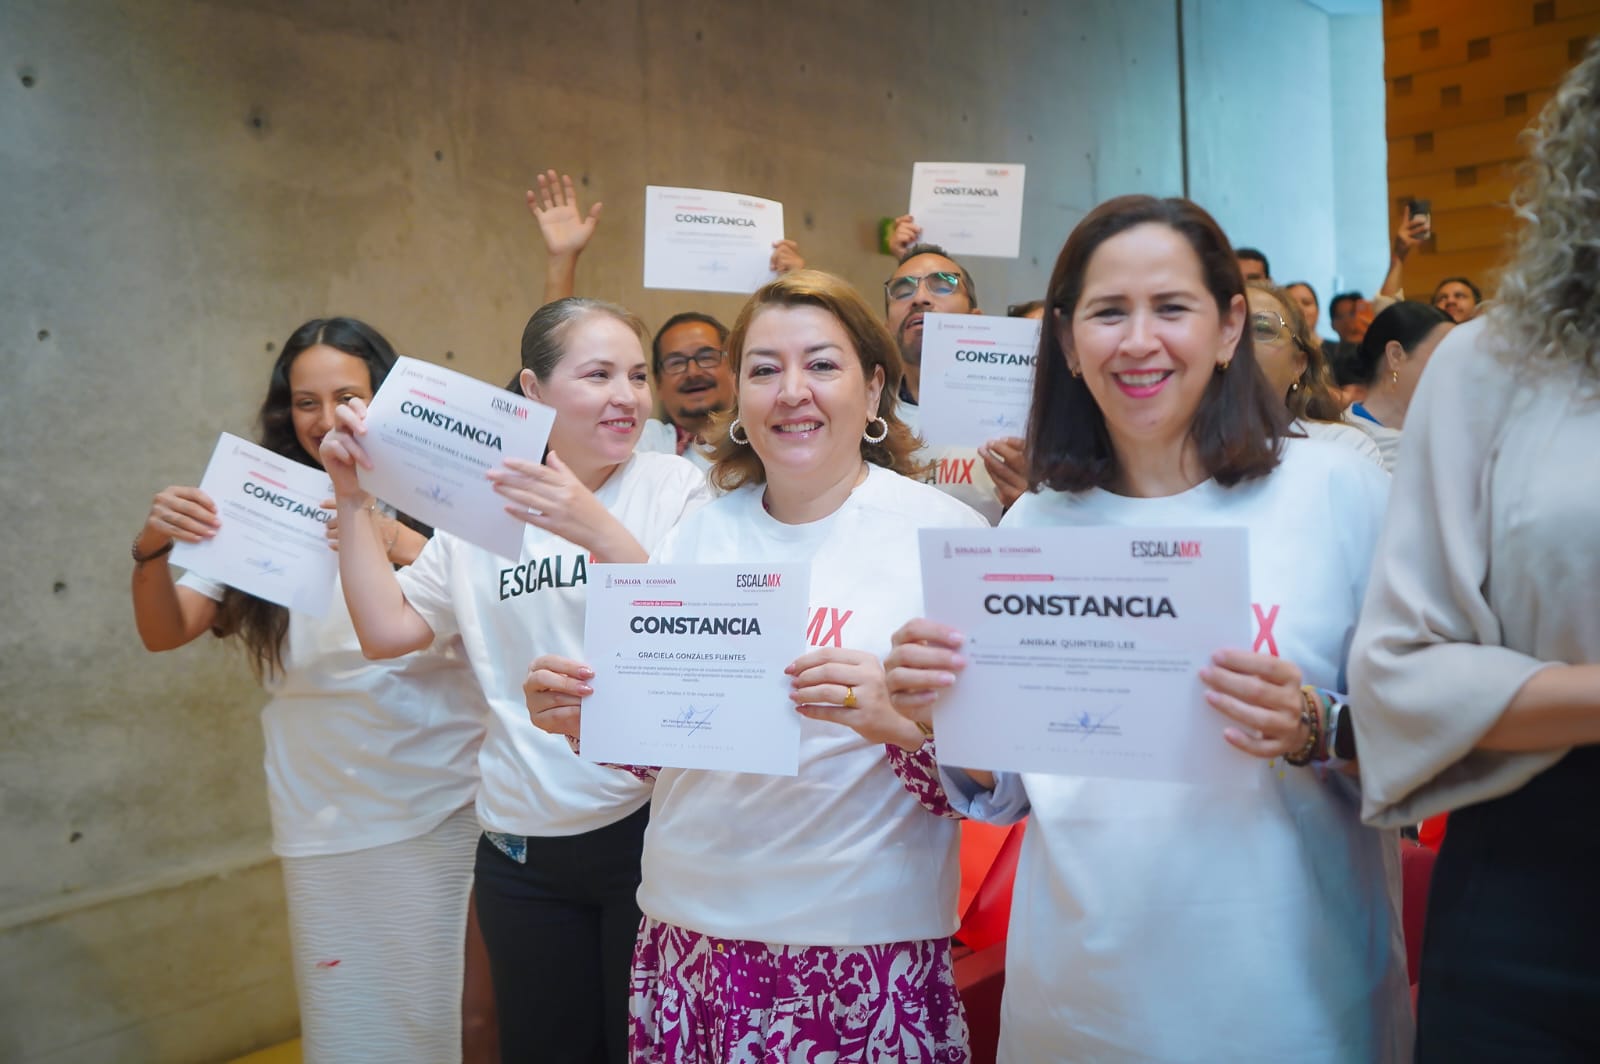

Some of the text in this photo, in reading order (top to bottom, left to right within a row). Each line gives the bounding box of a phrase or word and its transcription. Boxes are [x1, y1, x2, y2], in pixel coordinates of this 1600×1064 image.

[933, 186, 999, 197] CONSTANCIA
[675, 213, 757, 228] CONSTANCIA
[400, 400, 503, 451] CONSTANCIA
[1131, 540, 1201, 558] ESCALAMX
[500, 554, 594, 601] ESCALA
[736, 573, 781, 588] ESCALAMX
[984, 593, 1178, 619] CONSTANCIA
[629, 615, 761, 636] CONSTANCIA
[1060, 638, 1115, 649] QUINTERO
[1117, 640, 1136, 650] LEE
[638, 651, 673, 660] GRACIELA
[715, 653, 746, 662] FUENTES
